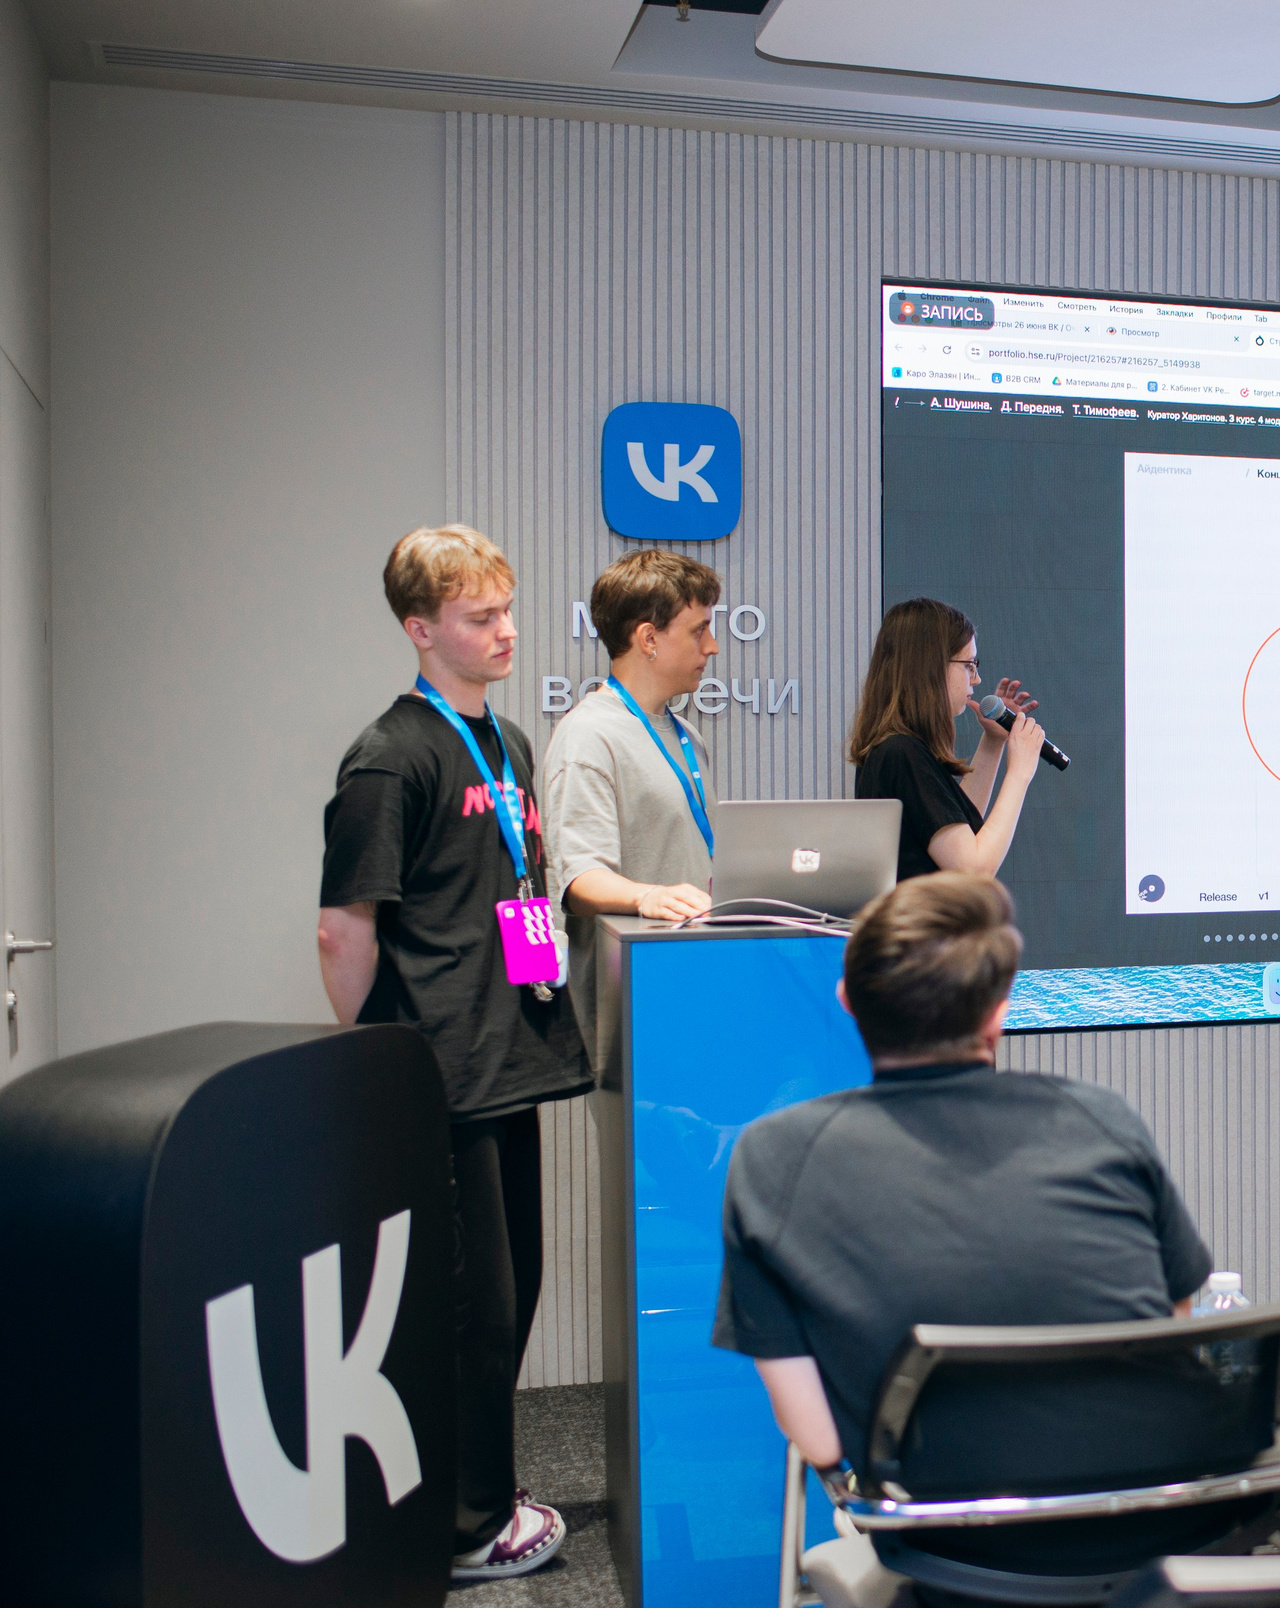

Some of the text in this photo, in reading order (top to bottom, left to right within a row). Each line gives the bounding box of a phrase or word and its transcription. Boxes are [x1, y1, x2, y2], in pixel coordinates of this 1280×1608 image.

[920, 293, 954, 302] Chrome
[1003, 298, 1044, 308] Изменить
[1058, 302, 1097, 311] Смотреть
[1110, 305, 1143, 314] История
[1156, 308, 1194, 318] Закладки
[1206, 312, 1242, 322] Профили
[1254, 315, 1268, 323] Tab
[920, 304, 984, 322] ЗАПИСЬ
[1121, 328, 1160, 338] Просмотр
[988, 348, 1201, 369] portfolio.hse.ru/Project/216257#216257_5149938
[906, 370, 926, 379] Каро
[928, 371, 958, 379] Элазян
[1006, 374, 1041, 384] B2B CRM
[1066, 377, 1109, 389] Материалы
[1111, 380, 1124, 389] для
[1170, 384, 1201, 392] Кабинет
[931, 397, 942, 408] А.
[944, 398, 992, 411] Шушина.
[1001, 401, 1012, 412] Д.
[1015, 402, 1064, 415] Передня.
[1072, 404, 1082, 415] Т.
[1085, 405, 1139, 419] Тимофеев.
[1148, 410, 1180, 422] Куратор
[1182, 411, 1228, 423] Харитонов.
[1229, 414, 1234, 422] 3
[1236, 416, 1256, 425] курс.
[1258, 416, 1264, 424] 4
[626, 442, 718, 503] VK
[1137, 464, 1192, 476] Айдентика
[1199, 892, 1269, 902] Release v1
[205, 1208, 422, 1564] VK
